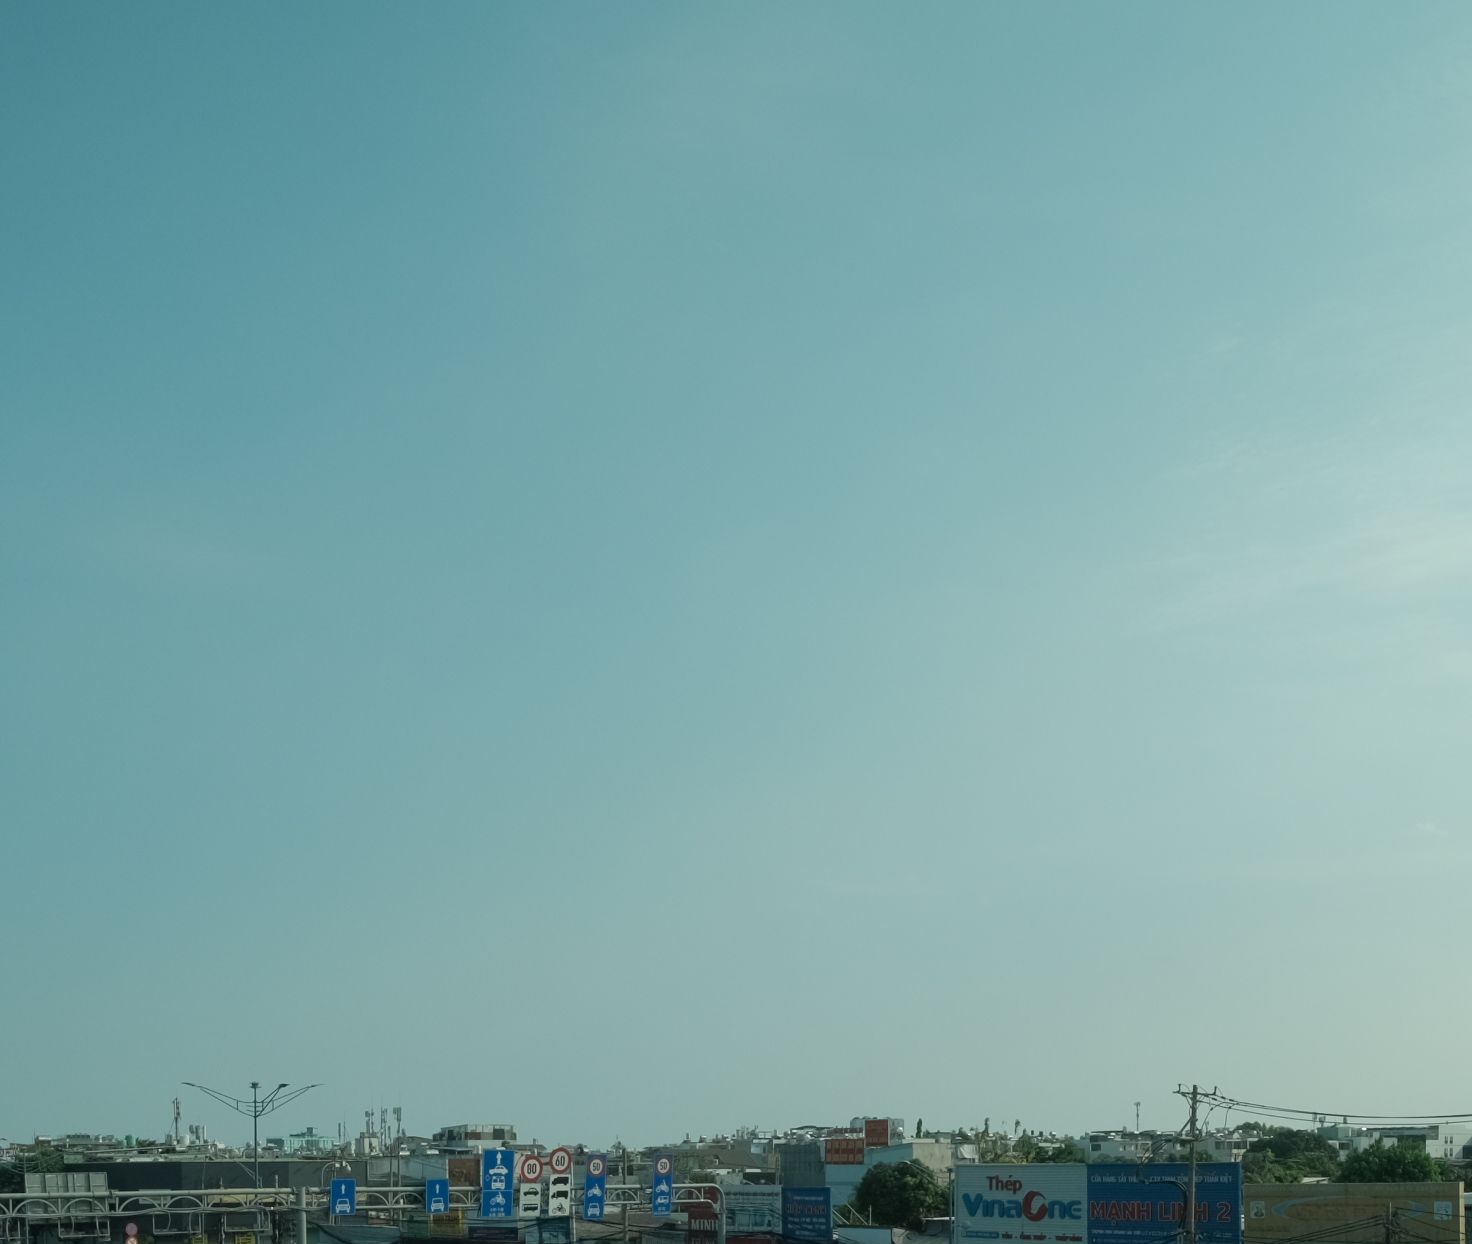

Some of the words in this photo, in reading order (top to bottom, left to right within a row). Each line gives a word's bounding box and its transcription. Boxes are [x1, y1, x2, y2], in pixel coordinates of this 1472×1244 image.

[555, 1155, 566, 1167] 60
[592, 1162, 601, 1171] 50
[659, 1161, 668, 1170] 50
[526, 1163, 537, 1174] 80
[987, 1175, 1023, 1194] Thép
[962, 1190, 1082, 1222] VinaOne
[1089, 1200, 1152, 1226] MẠNH
[1216, 1202, 1232, 1223] 2
